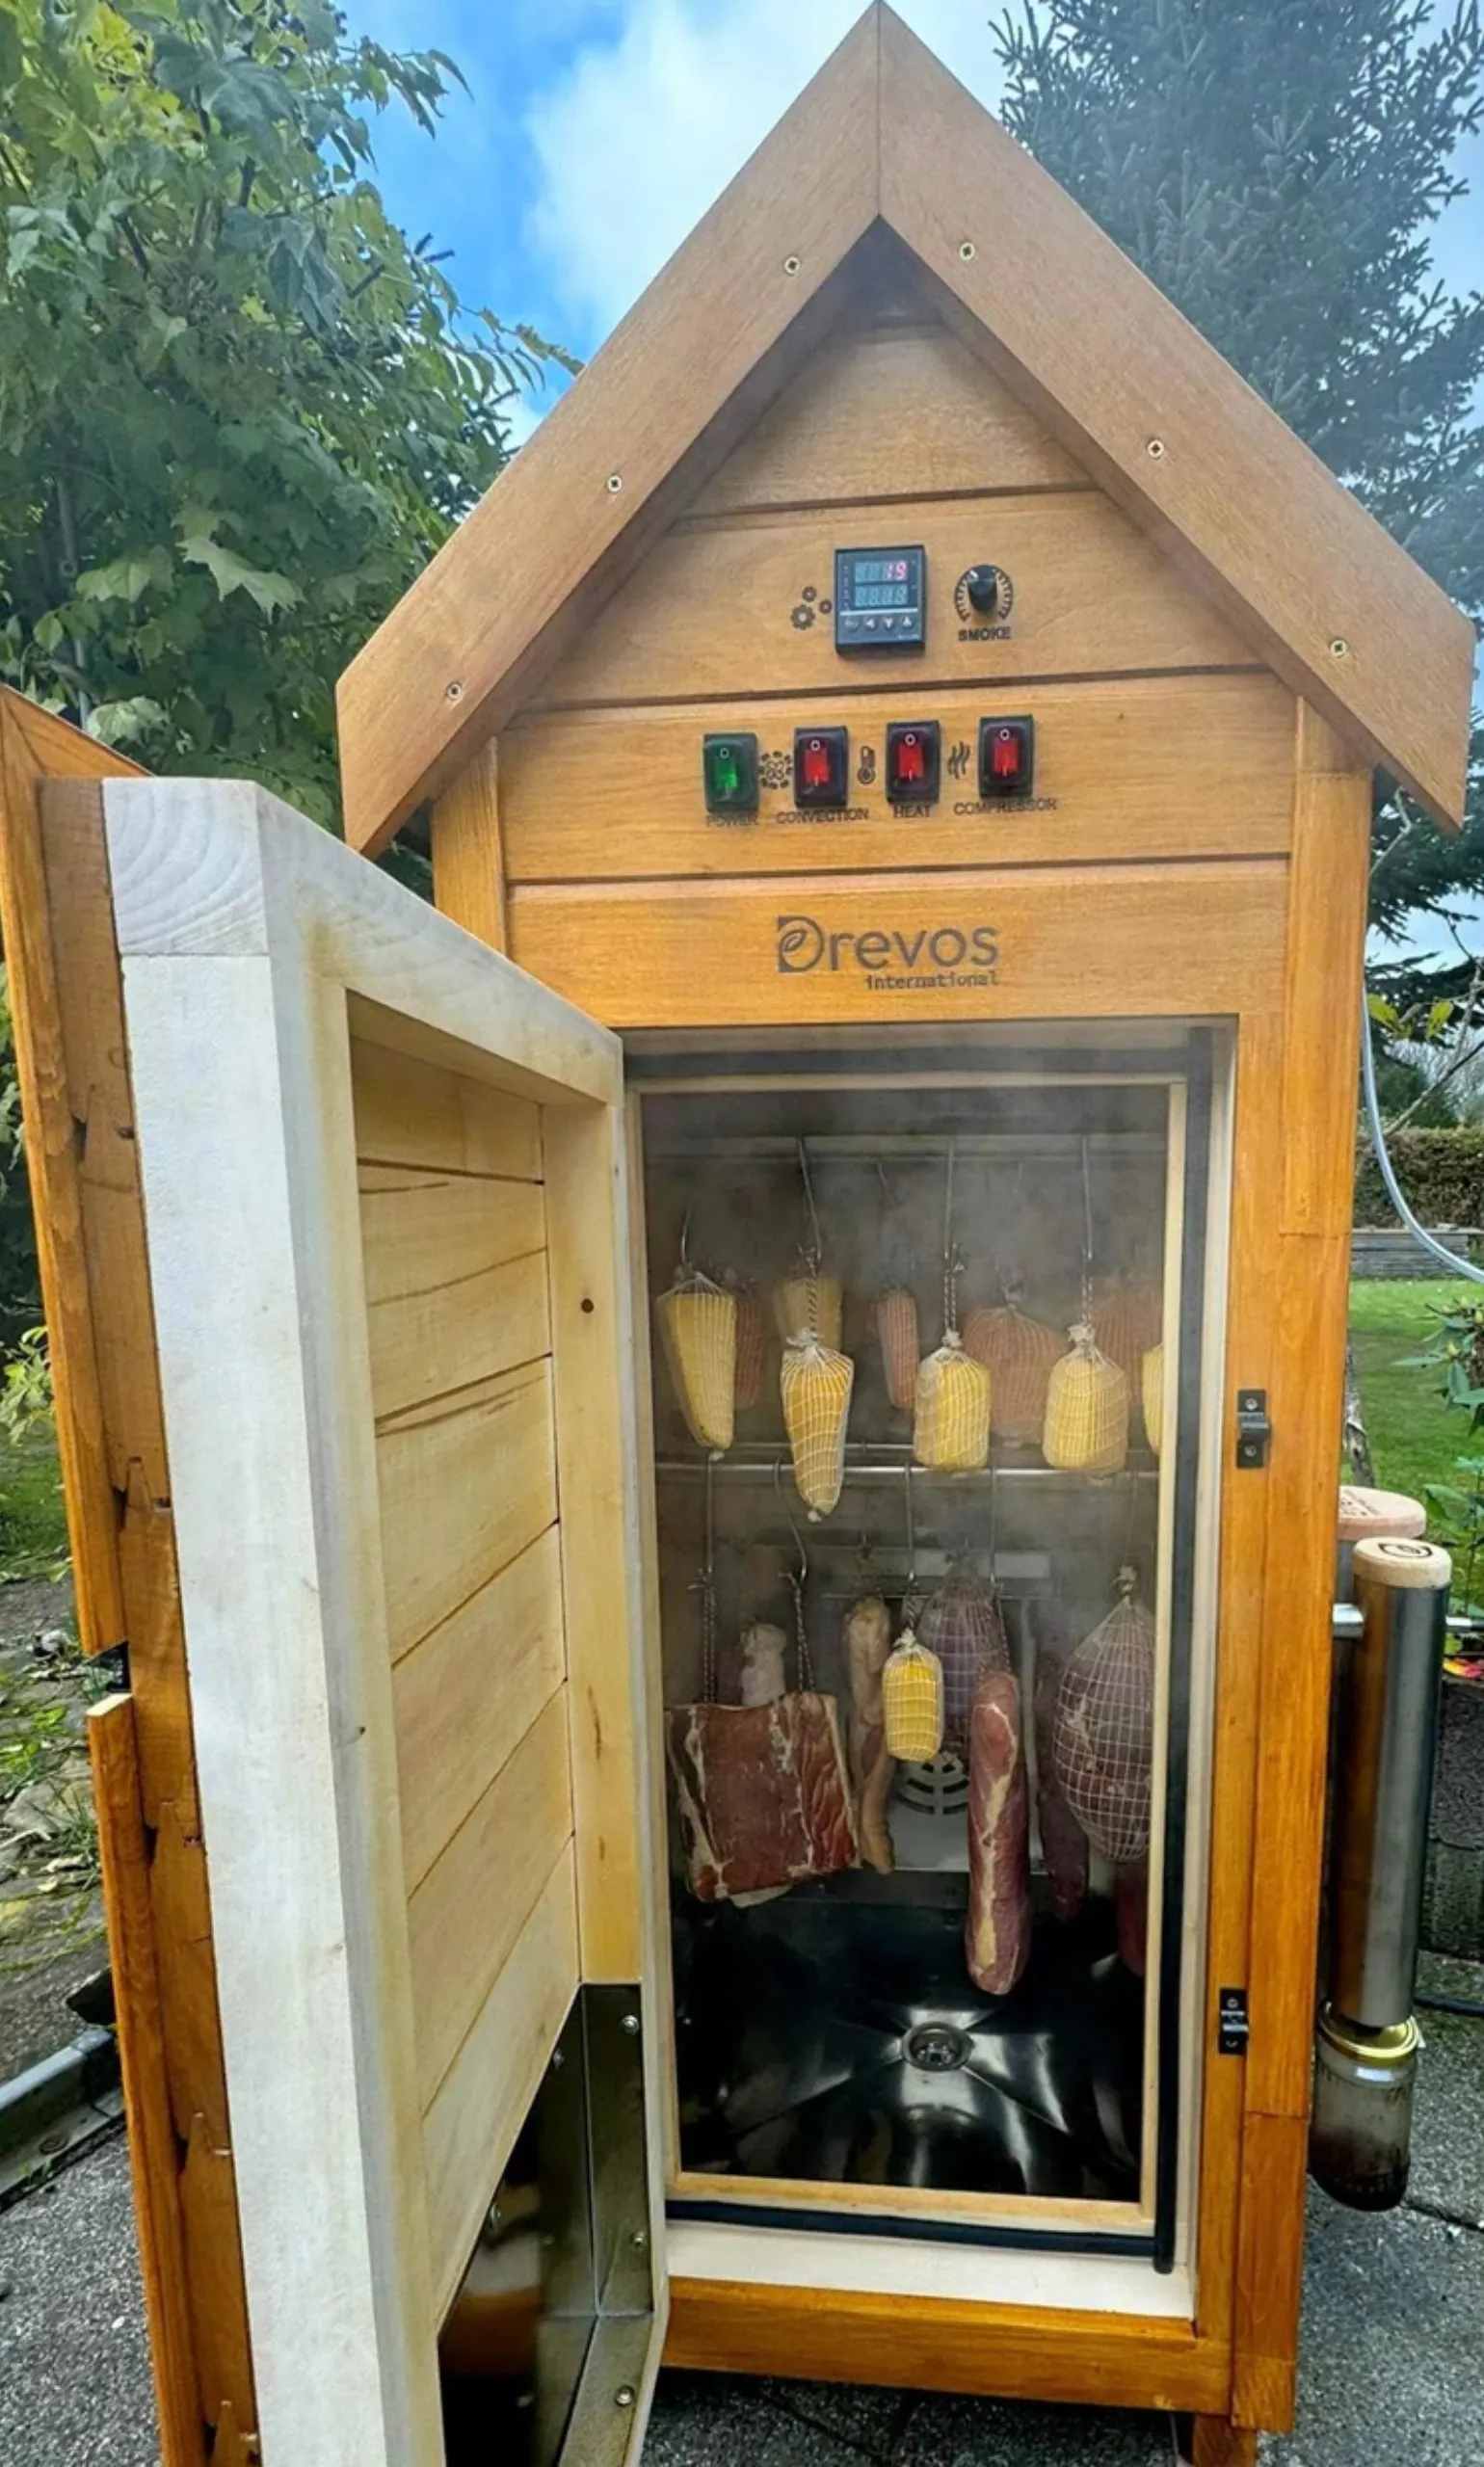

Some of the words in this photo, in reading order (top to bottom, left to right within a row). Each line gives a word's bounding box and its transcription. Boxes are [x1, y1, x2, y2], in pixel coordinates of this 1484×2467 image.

[959, 627, 1011, 641] SMOKE
[893, 804, 933, 818] HEAT
[953, 798, 1057, 816] COMPRESSOR
[705, 810, 760, 828] POWER
[776, 808, 869, 825] CONVECTION
[777, 915, 1001, 973] Drevos
